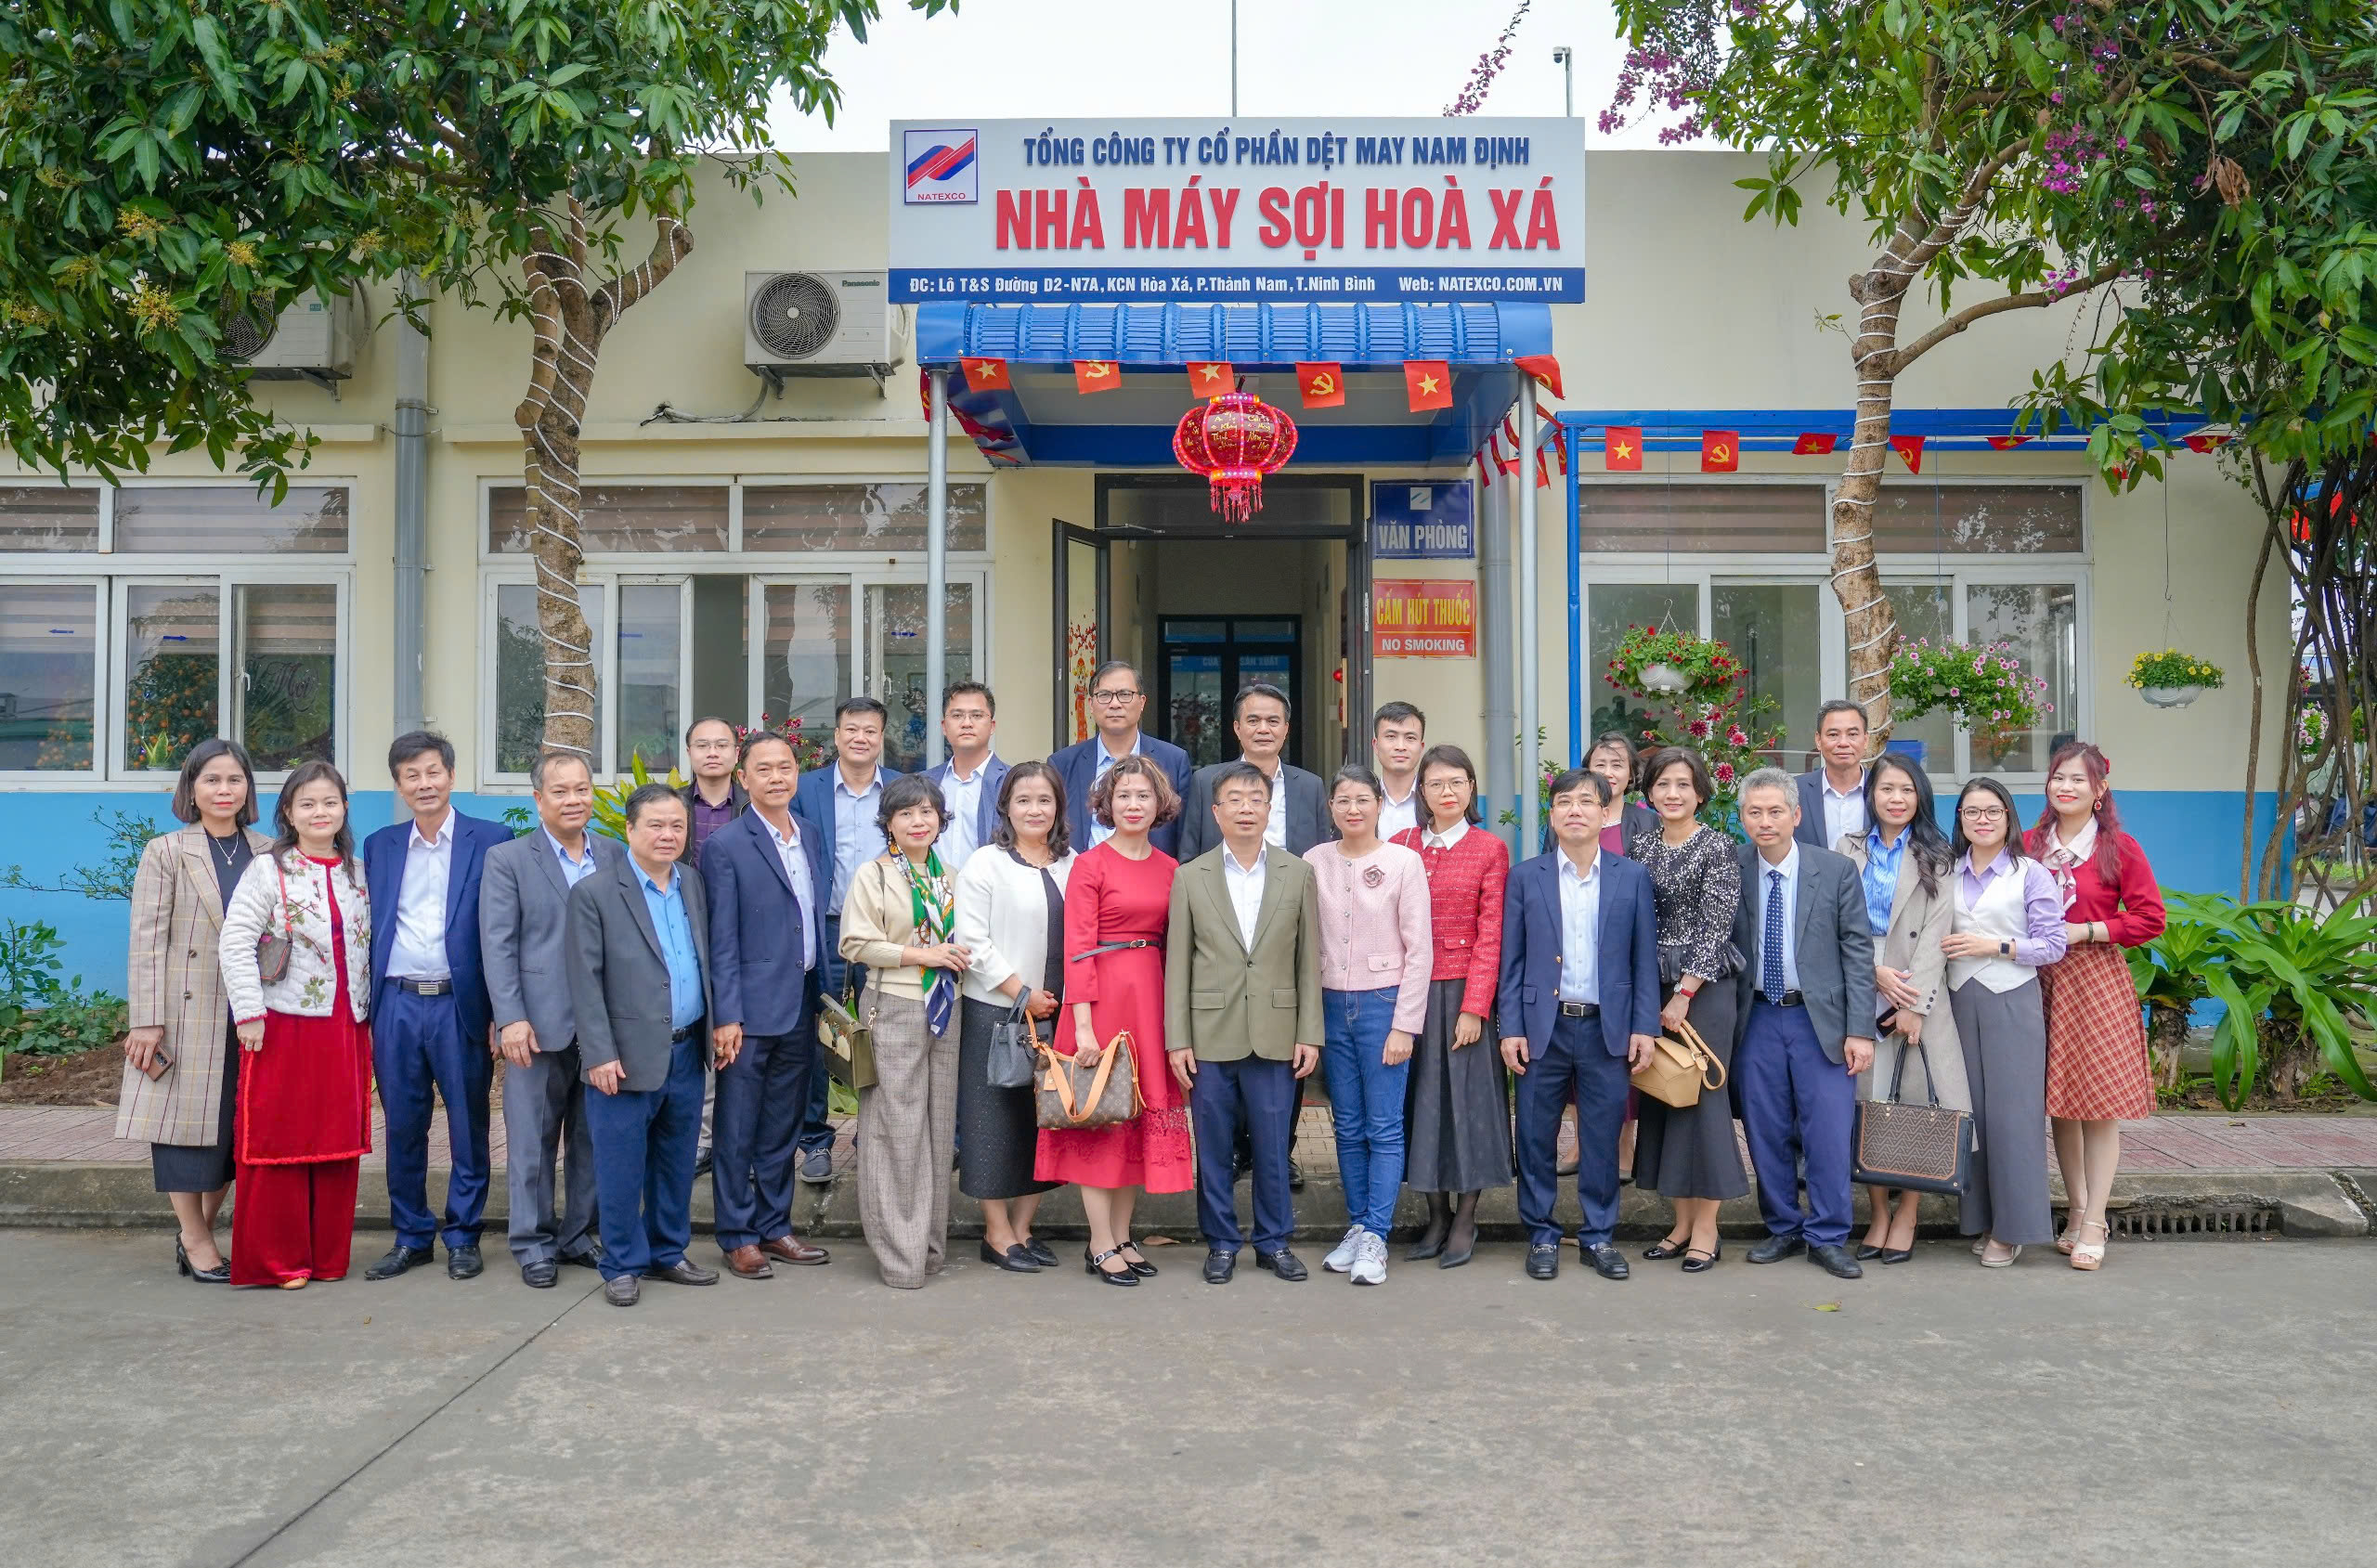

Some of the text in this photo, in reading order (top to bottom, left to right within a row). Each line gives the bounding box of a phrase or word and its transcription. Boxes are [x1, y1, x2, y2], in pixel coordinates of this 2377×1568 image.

[1024, 126, 1530, 170] TỔNG CÔNG TY CỔ PHẦN DỆT MAY NAM ĐỊNH
[917, 192, 967, 201] NATEXCO
[995, 175, 1561, 260] NHÀ MÁY SỢI HOÀ XÁ
[909, 277, 935, 292] ĐC:
[939, 277, 955, 292] Lô
[959, 277, 990, 292] T&S
[994, 276, 1038, 294] Đường
[1140, 276, 1167, 292] Hòa
[1344, 275, 1376, 292] Bình
[1398, 276, 1435, 292] Web:
[1438, 276, 1563, 292] NATEXCO.COM.VN
[1378, 519, 1468, 550] VĂN PHÒNG
[1376, 589, 1471, 626] CẤM HÚT THUỐC
[1382, 638, 1465, 652] NO SMOKING
